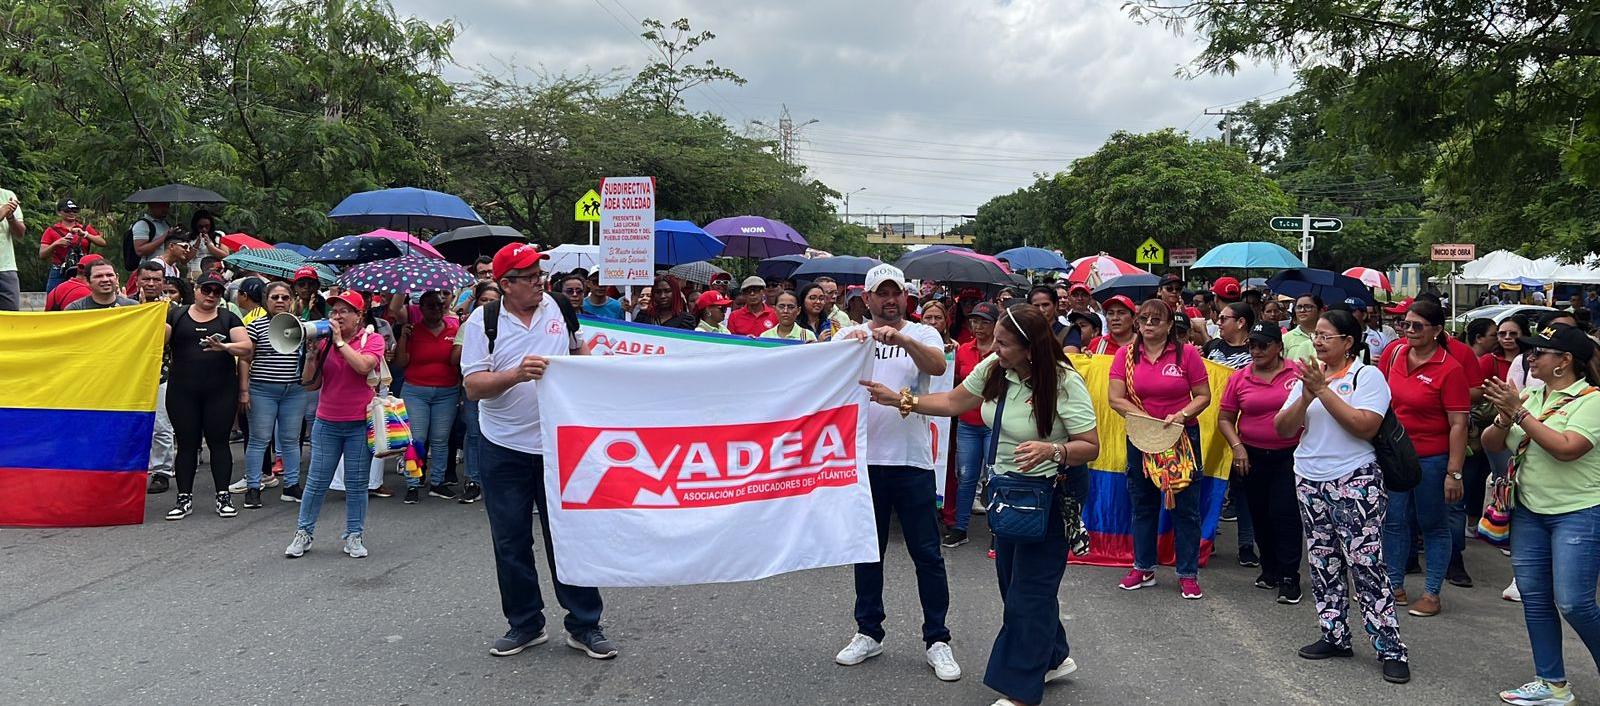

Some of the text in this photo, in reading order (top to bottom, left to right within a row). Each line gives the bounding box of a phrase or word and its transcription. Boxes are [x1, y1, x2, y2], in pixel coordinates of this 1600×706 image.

[604, 182, 651, 195] SUBDIRECTIVA
[604, 197, 651, 210] ADEA SOLEDAD
[616, 340, 666, 355] ADEA
[676, 423, 848, 480] ADEA
[683, 468, 858, 501] ASOCIACIÓN DE EDUCADORES DEL ATLÁNTICO
